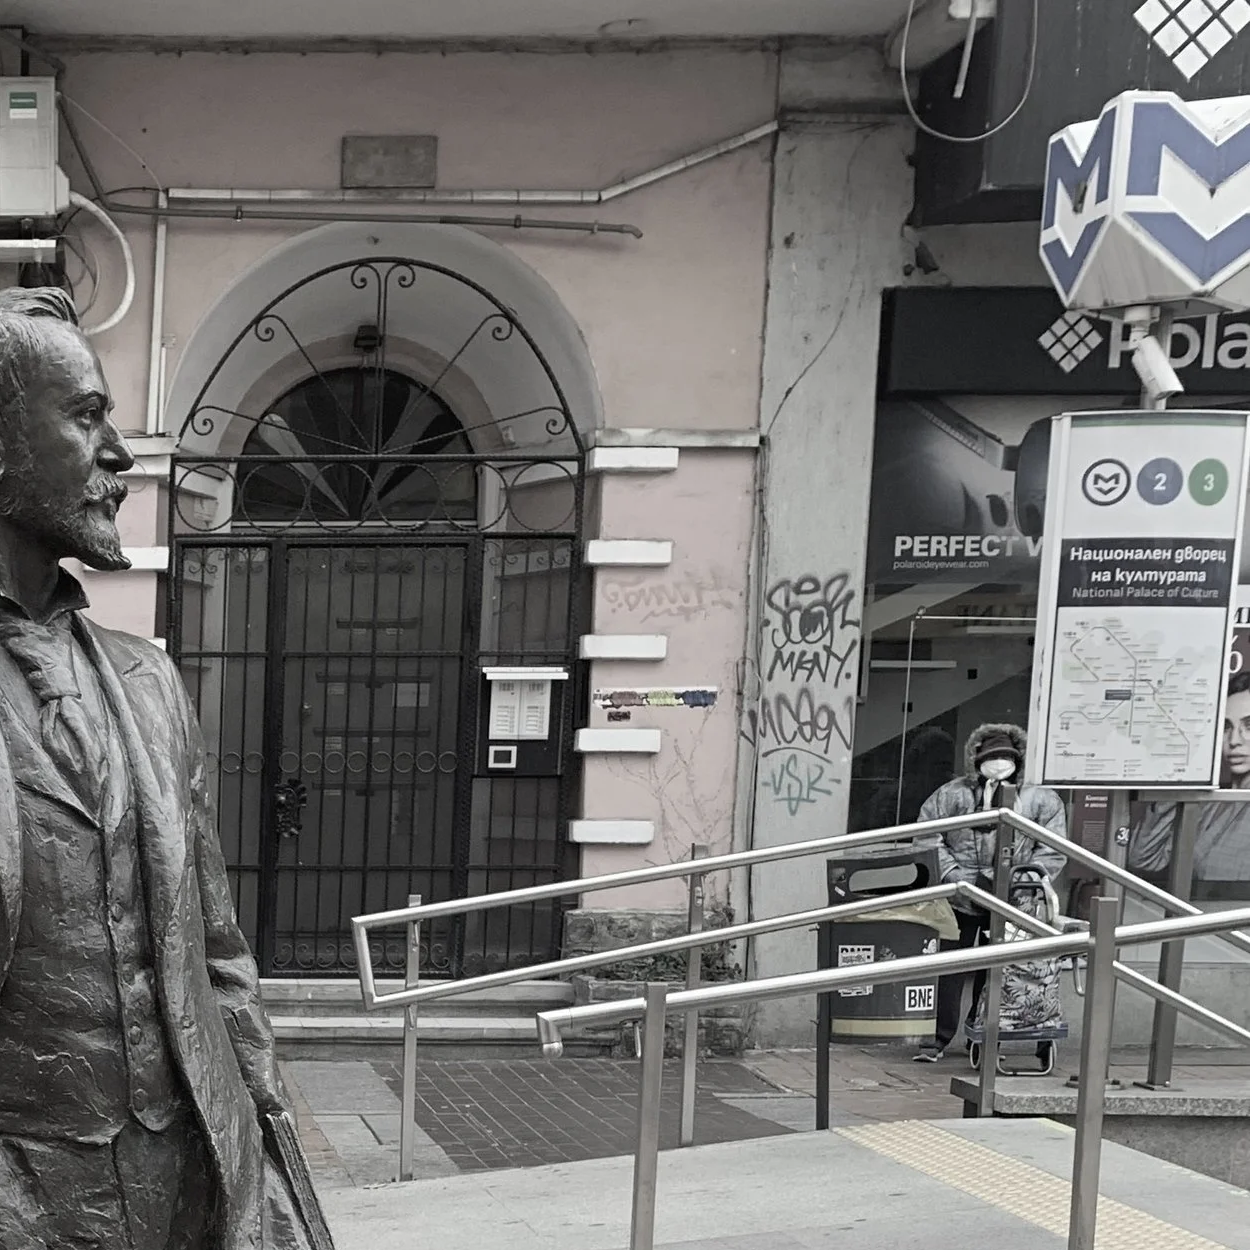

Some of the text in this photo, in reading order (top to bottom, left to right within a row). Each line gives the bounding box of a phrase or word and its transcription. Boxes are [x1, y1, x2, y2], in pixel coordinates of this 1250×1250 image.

[1153, 472, 1167, 491] 2
[1203, 473, 1216, 492] 3
[894, 535, 1020, 557] PERFECT
[1070, 545, 1227, 564] Национален дворец
[892, 559, 990, 571] polaroideyewear.com
[1091, 567, 1207, 585] на културата
[1072, 586, 1219, 599] National Palace of Culture
[908, 988, 933, 1009] BNE
